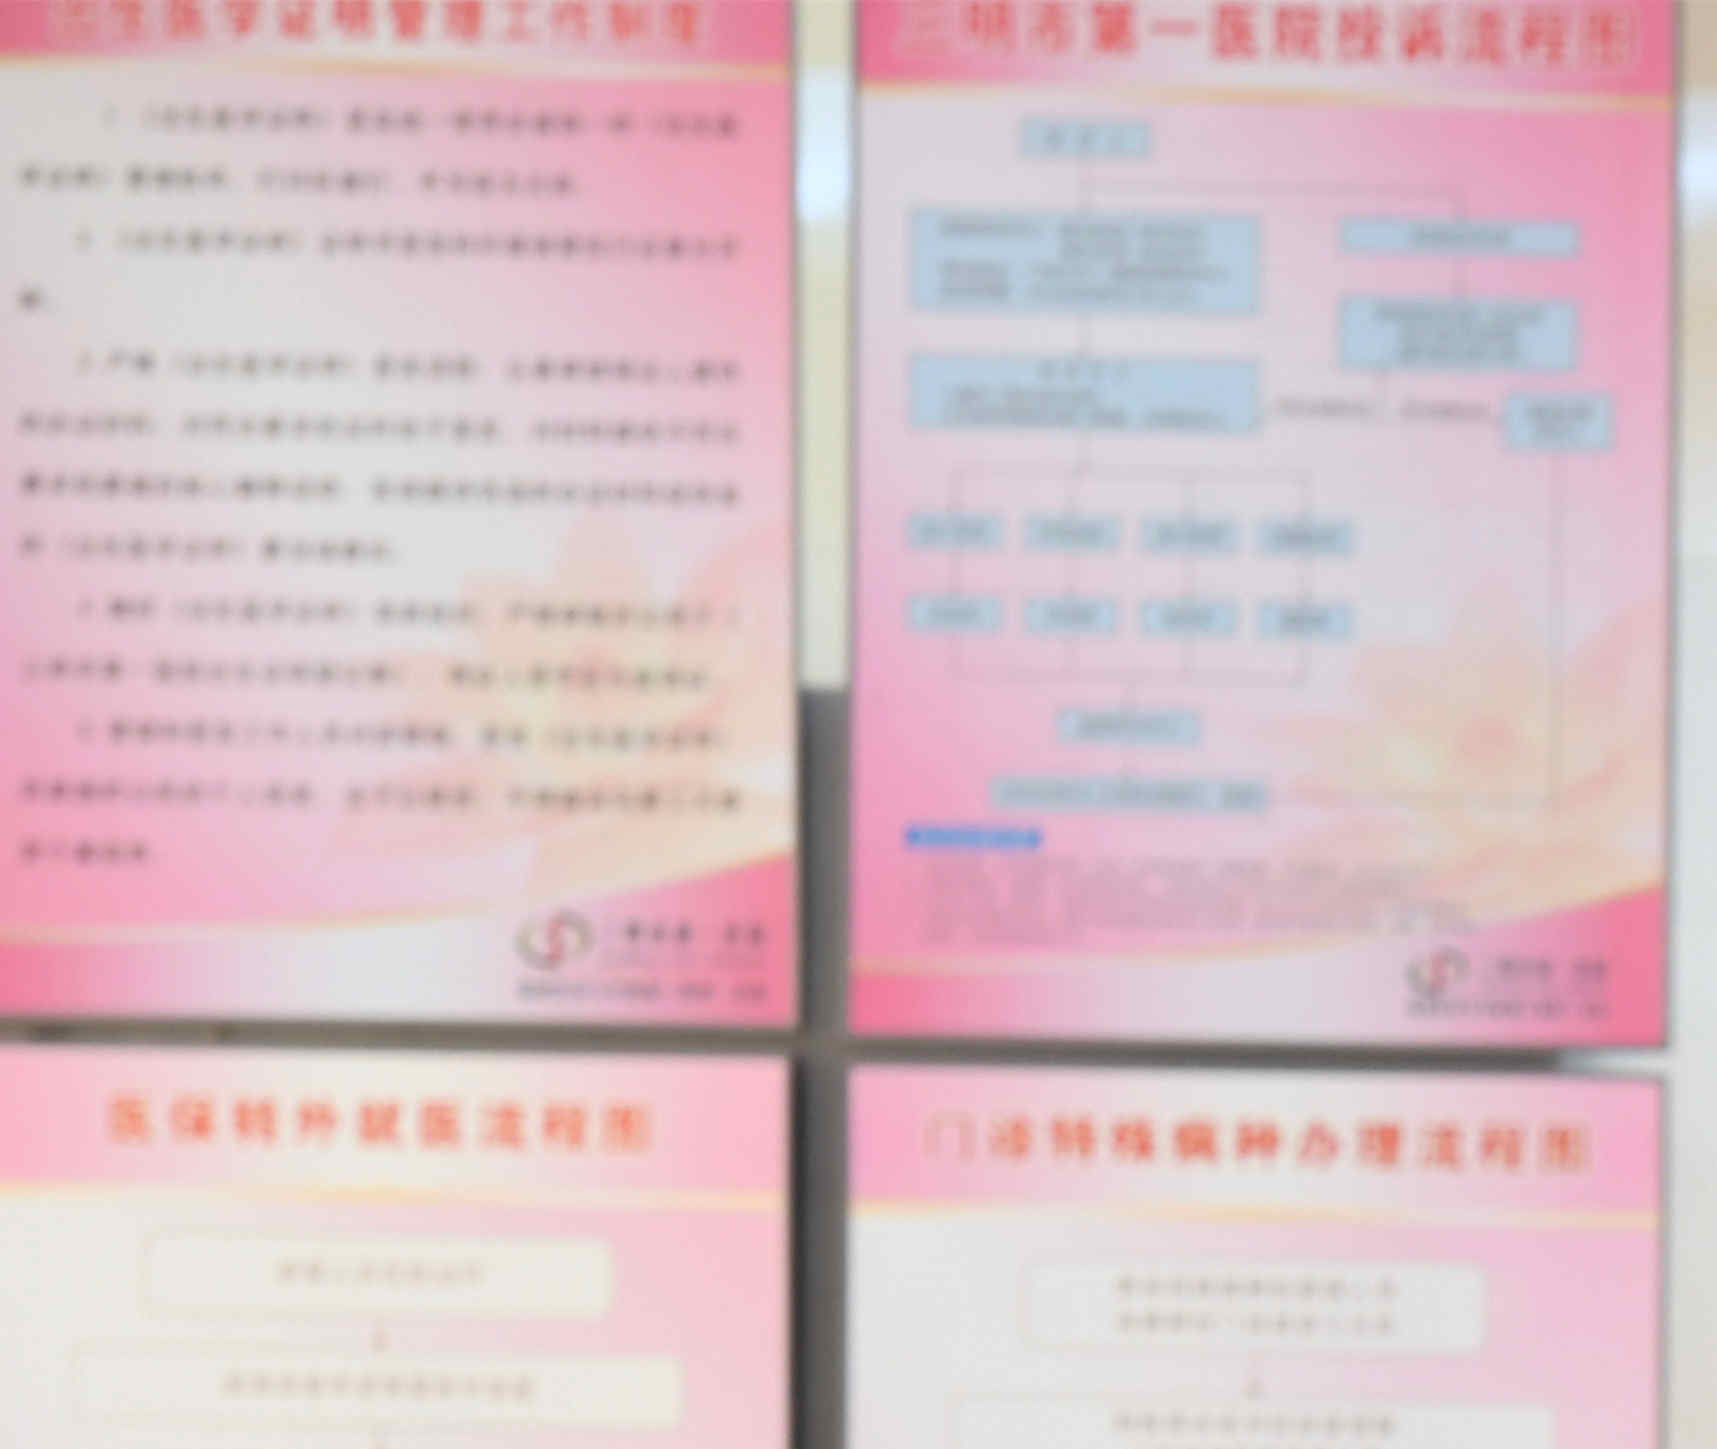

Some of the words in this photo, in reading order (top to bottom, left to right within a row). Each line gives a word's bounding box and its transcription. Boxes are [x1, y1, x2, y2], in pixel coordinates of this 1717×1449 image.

[105, 1092, 656, 1153] 医保转外就医流程图
[923, 1112, 1593, 1176] 门诊特殊病种办理流程图
